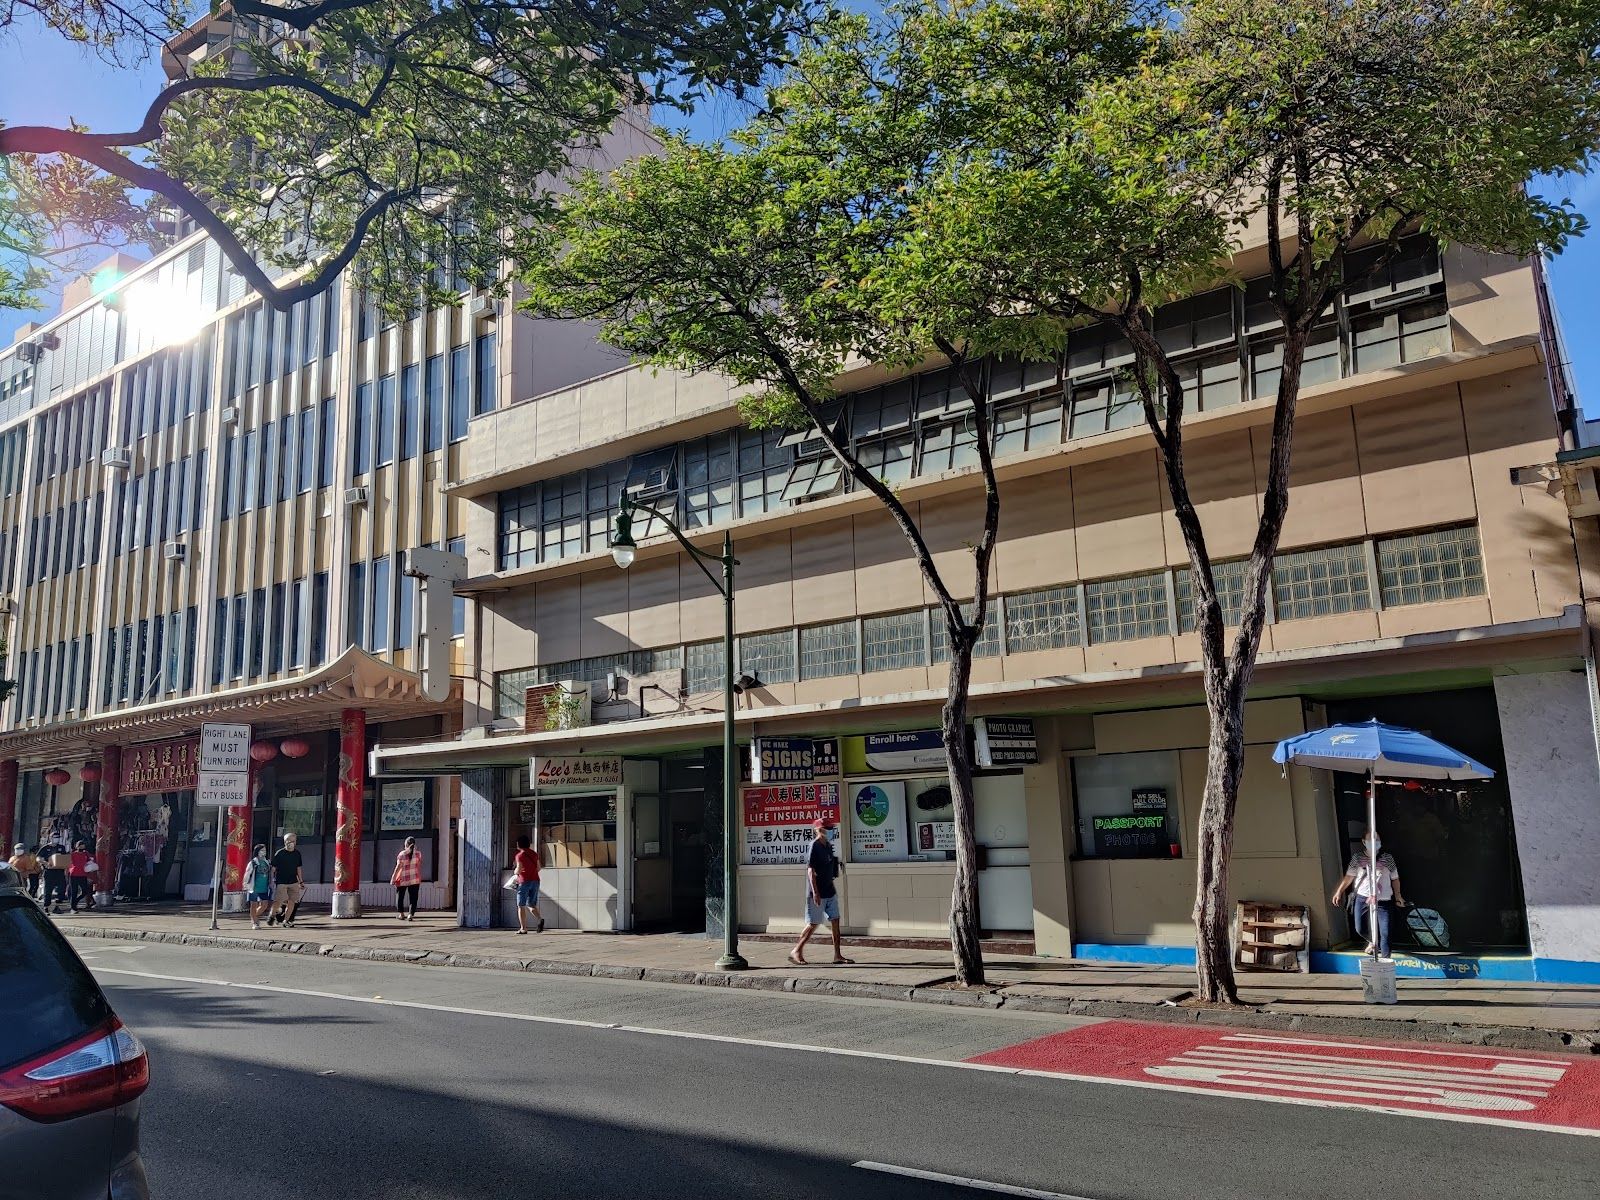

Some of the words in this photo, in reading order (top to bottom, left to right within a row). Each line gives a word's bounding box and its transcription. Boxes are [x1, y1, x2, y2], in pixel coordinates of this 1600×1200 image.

[204, 729, 226, 738] RIGHT
[229, 730, 247, 739] LANE
[869, 734, 895, 745] Enroll
[896, 734, 919, 742] here.
[212, 743, 239, 753] MUST
[772, 741, 789, 749] MAKE
[203, 757, 222, 766] TURN
[225, 757, 247, 766] RIGHT
[762, 750, 812, 768] SIGNS
[538, 759, 571, 777] Lee's
[129, 766, 165, 782] GOLDEN
[762, 769, 812, 780] BANNERS
[210, 779, 237, 787] EXCEPT
[537, 778, 559, 786] Bakery
[202, 792, 218, 800] CITY
[220, 792, 243, 800] BUSES
[766, 786, 816, 803] 人寿保险
[750, 812, 769, 822] LIFE
[773, 809, 834, 821] INSURANCE
[1094, 816, 1164, 830] PASSPORT
[1104, 832, 1157, 846] PHOTOS
[750, 845, 782, 855] HEALTH
[751, 856, 769, 864] Please
[1395, 959, 1421, 968] WATCH
[1448, 962, 1470, 973] STEP
